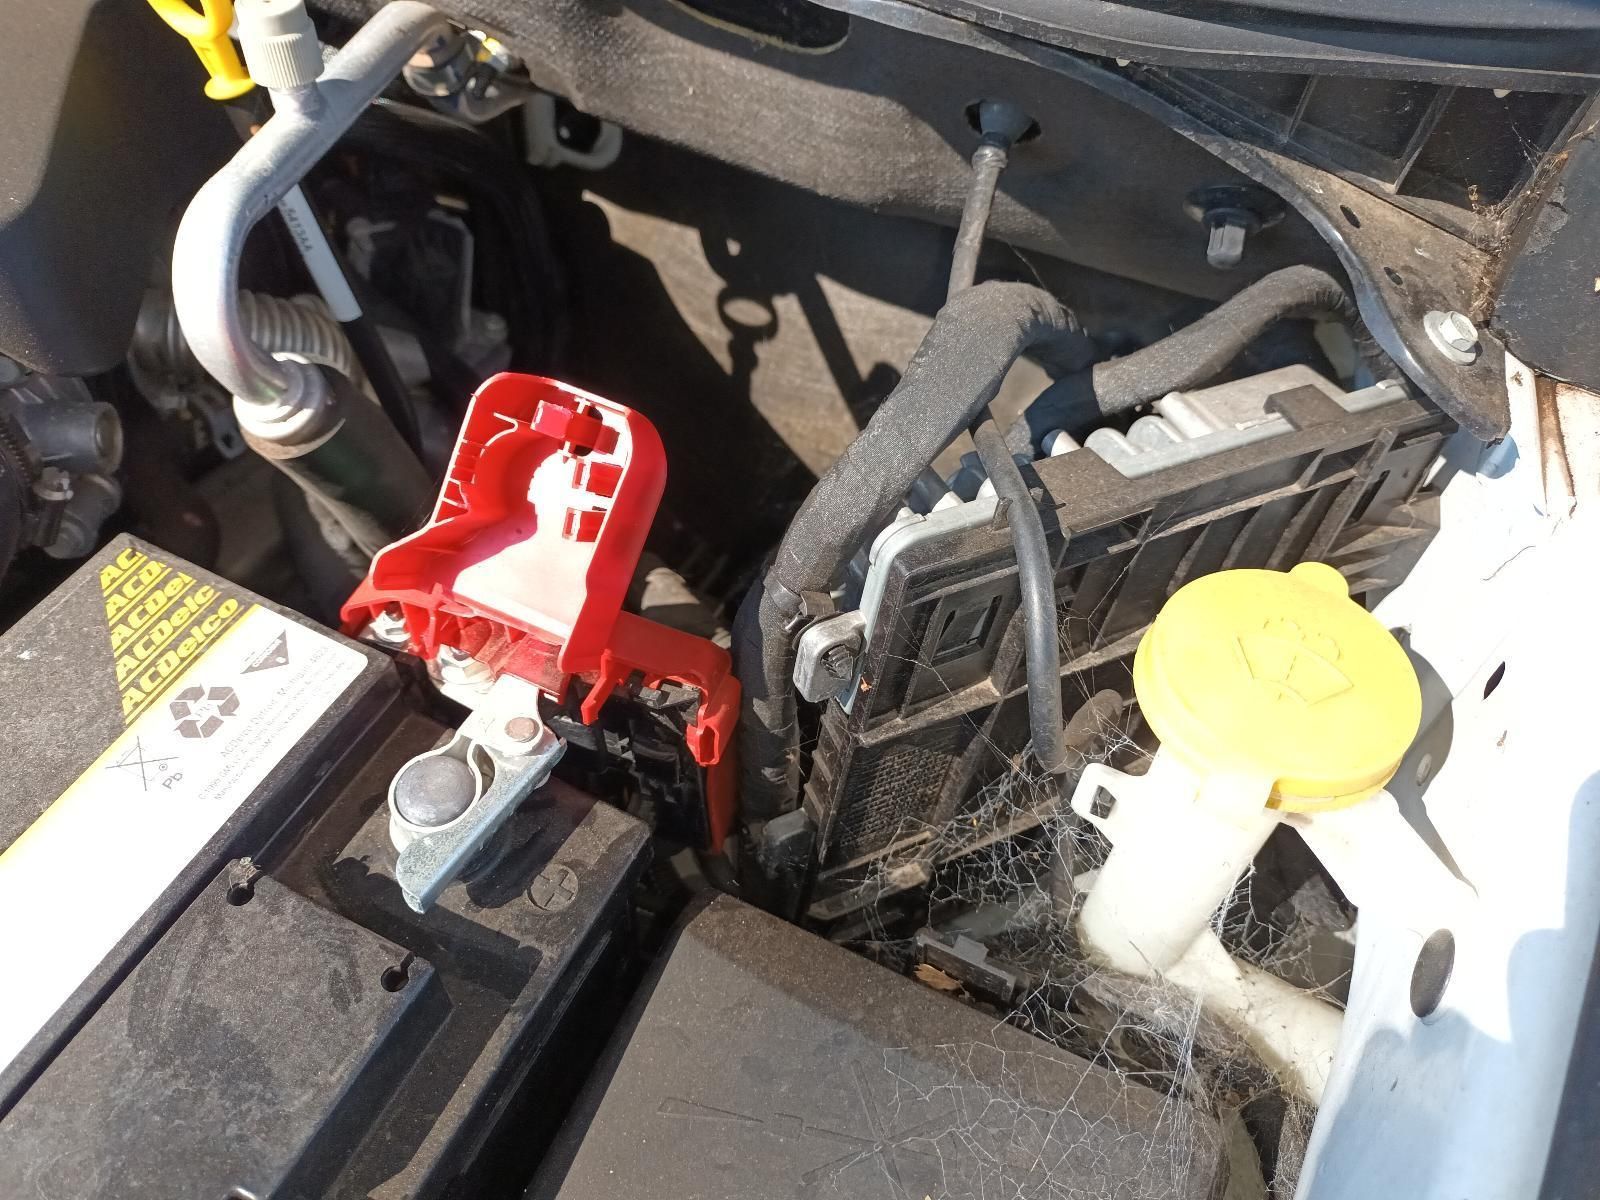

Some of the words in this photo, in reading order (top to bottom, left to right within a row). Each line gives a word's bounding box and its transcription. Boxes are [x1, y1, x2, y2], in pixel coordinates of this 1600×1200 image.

[100, 548, 143, 590] AC
[106, 561, 167, 619] ACD
[116, 585, 214, 681] ACDelc
[122, 599, 239, 716] ACDelco
[162, 773, 183, 789] Pb
